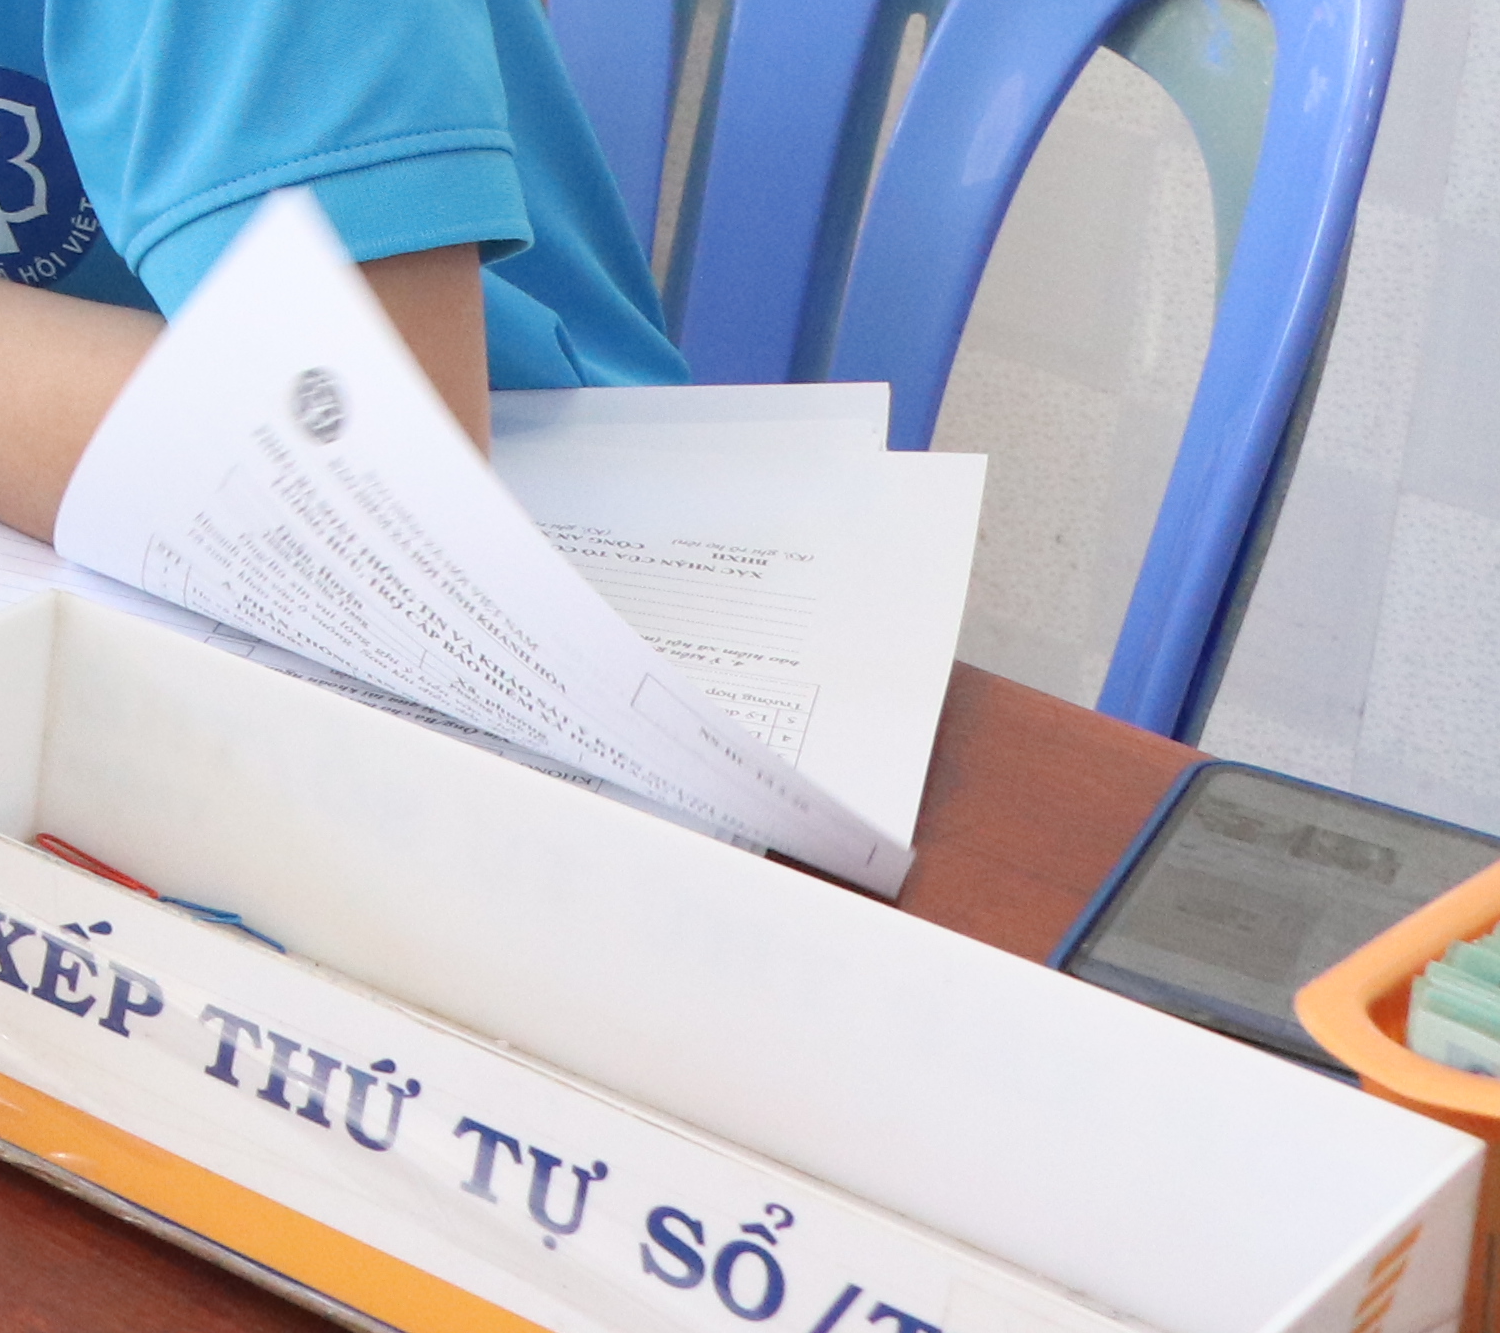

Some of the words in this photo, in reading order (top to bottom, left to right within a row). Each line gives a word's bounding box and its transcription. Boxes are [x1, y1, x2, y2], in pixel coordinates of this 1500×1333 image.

[200, 1003, 422, 1152] THỨ
[452, 1115, 609, 1251] TỰ
[639, 1202, 795, 1323] SỔ
